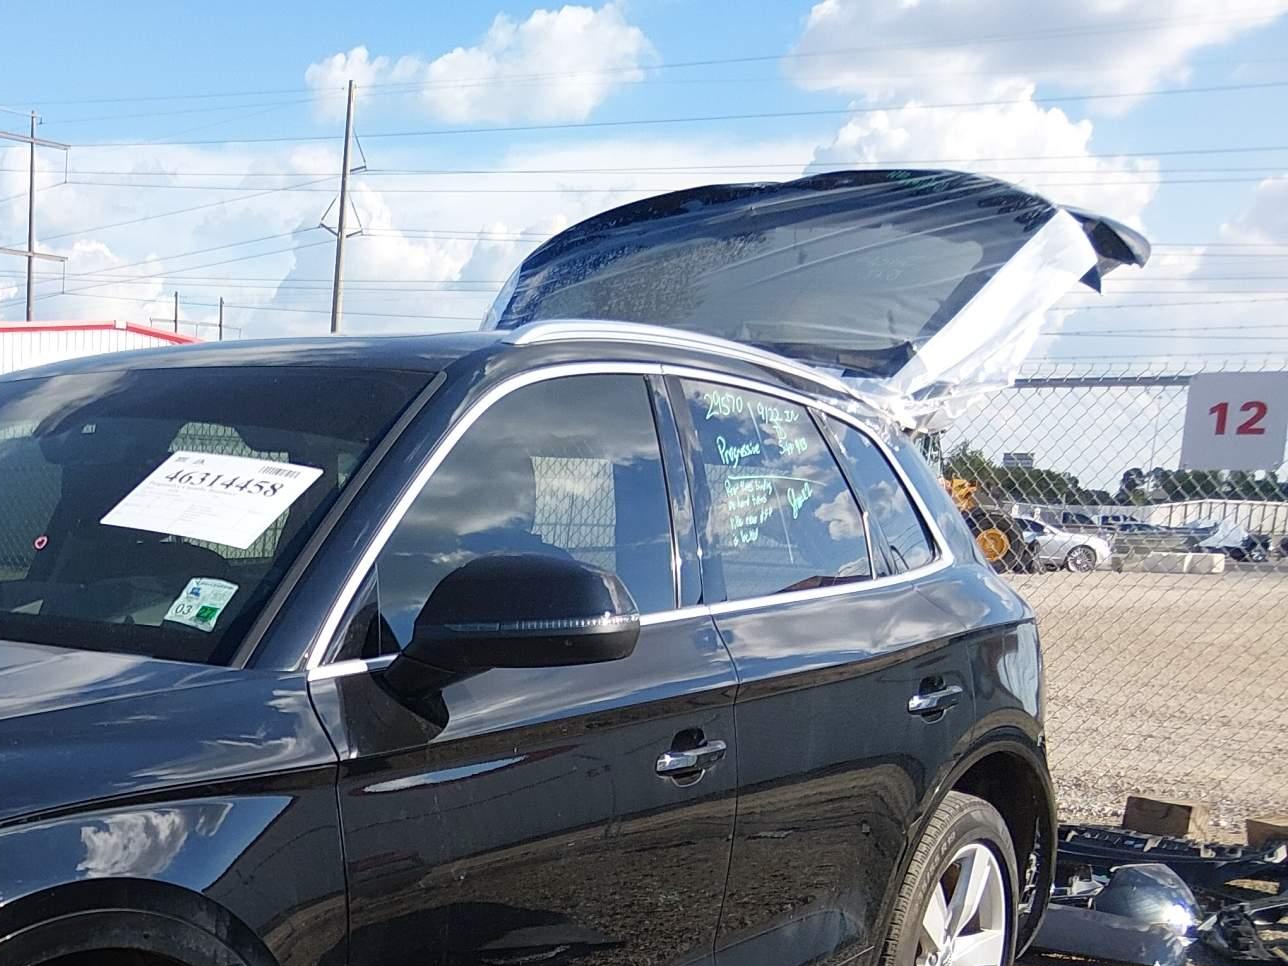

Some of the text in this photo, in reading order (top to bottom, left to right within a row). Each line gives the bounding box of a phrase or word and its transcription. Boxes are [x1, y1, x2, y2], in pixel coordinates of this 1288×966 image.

[1208, 400, 1268, 435] 12
[716, 435, 761, 468] Progressive
[165, 468, 285, 498] 46314458
[175, 603, 193, 616] 03
